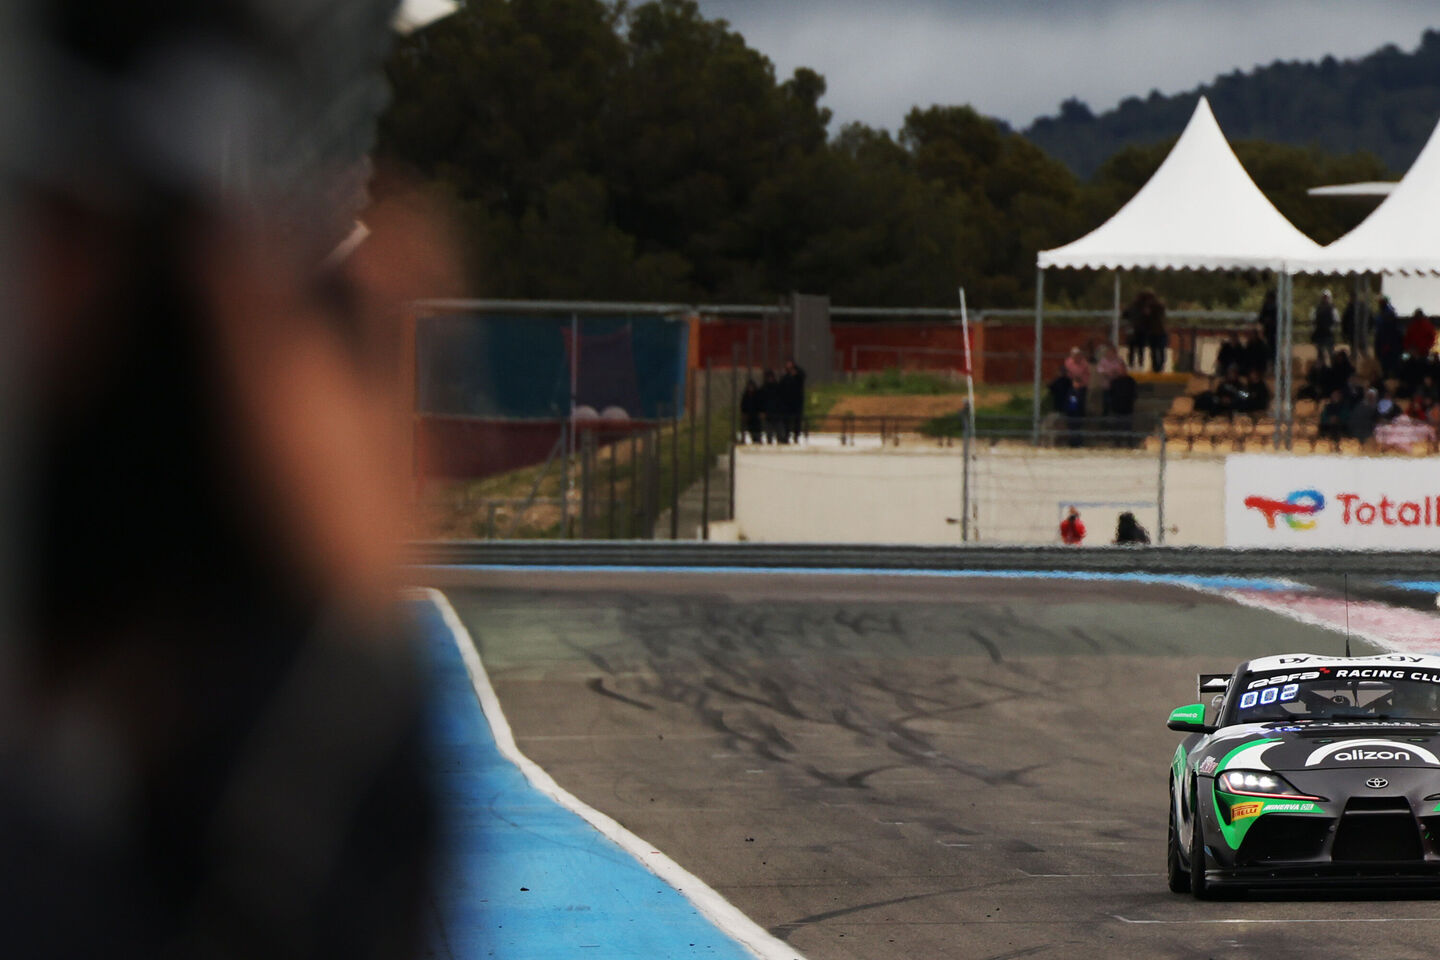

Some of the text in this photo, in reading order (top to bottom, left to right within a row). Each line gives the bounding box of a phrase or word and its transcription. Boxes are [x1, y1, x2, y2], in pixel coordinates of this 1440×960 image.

[1335, 668, 1405, 680] RACING
[1239, 683, 1300, 710] 002
[1334, 749, 1411, 761] alizon
[1262, 803, 1300, 812] MINERVA
